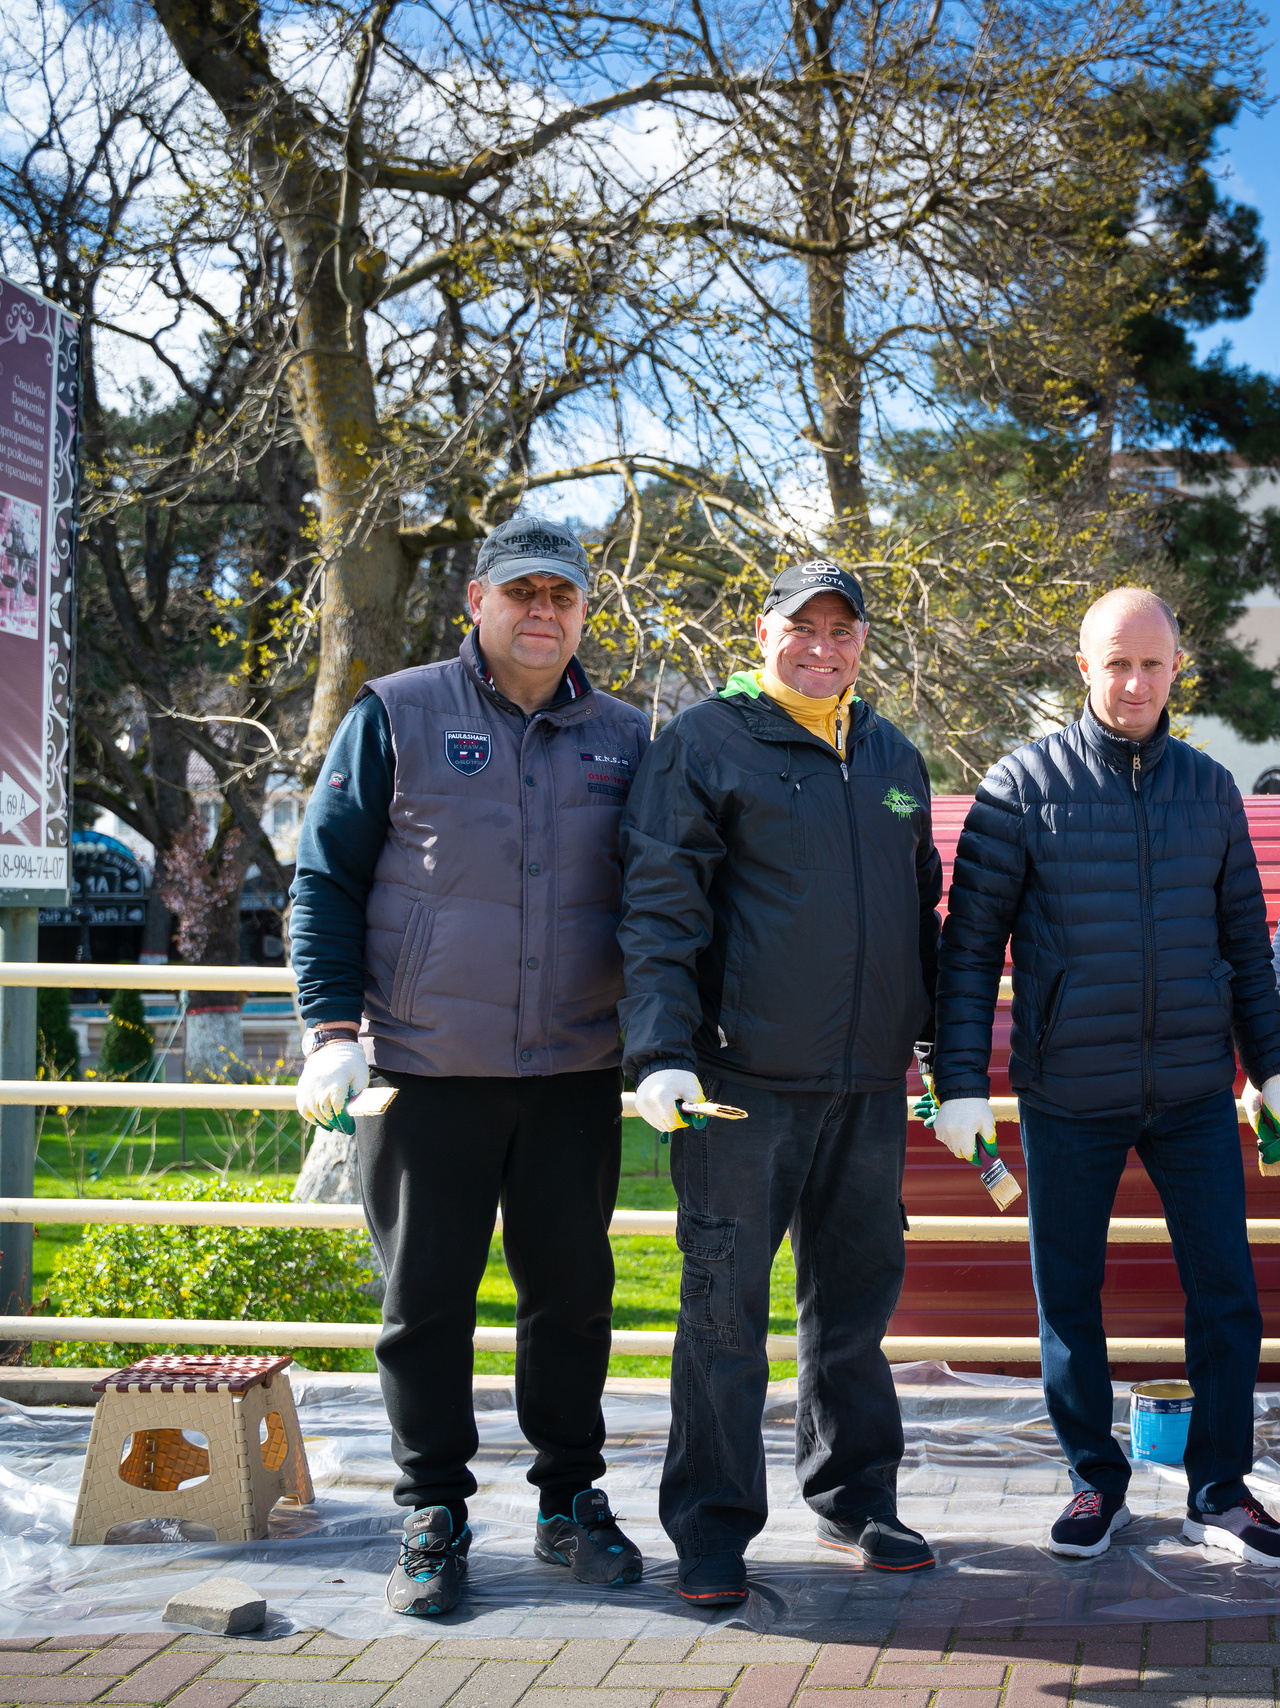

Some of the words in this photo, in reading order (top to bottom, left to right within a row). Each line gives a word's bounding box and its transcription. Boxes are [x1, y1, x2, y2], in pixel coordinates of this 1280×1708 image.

[13, 374, 46, 400] Свадьбы
[11, 391, 45, 418] Банкеты
[7, 446, 44, 470] рождения
[5, 463, 43, 488] праздники
[503, 533, 571, 548] TRUSSARDI
[518, 543, 560, 554] JEANS
[800, 575, 846, 588] TOYOTA
[447, 733, 488, 742] PAUL&SHARK
[587, 772, 610, 782] OSLO
[6, 794, 17, 815] 69
[0, 854, 65, 879] 8-994-74-07
